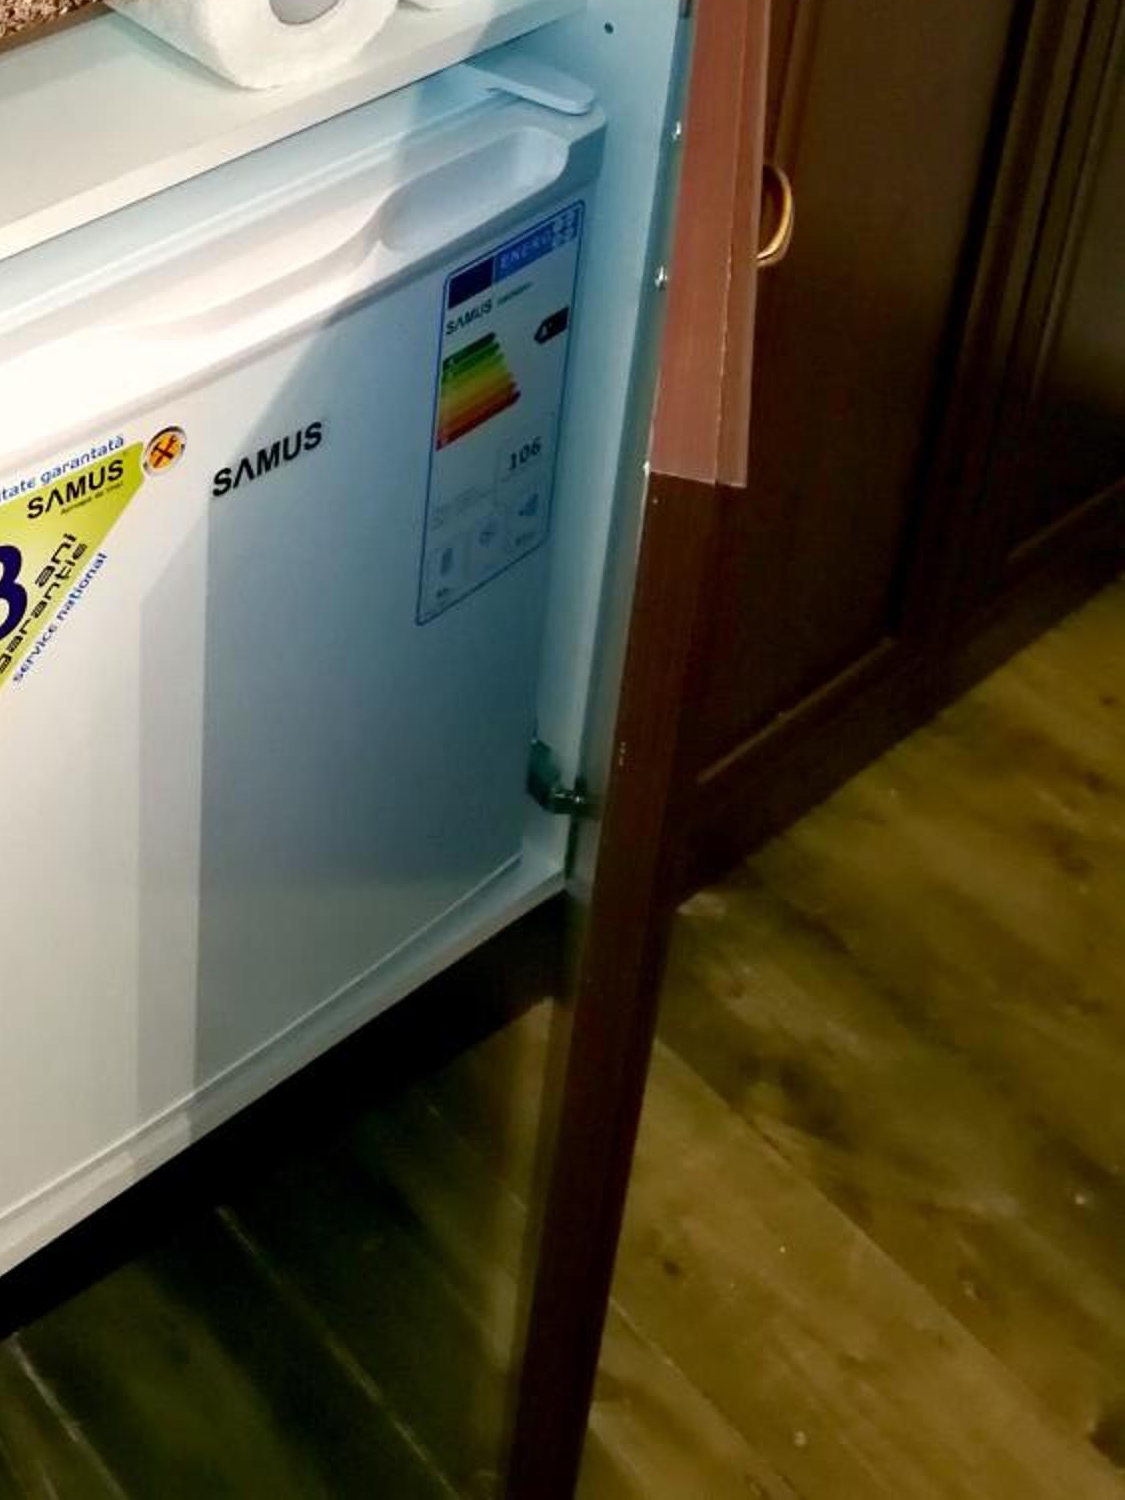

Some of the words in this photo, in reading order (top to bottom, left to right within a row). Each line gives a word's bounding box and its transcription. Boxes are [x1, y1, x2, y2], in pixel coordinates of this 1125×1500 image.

[445, 299, 492, 335] SAMUS
[212, 421, 322, 496] SAMUS
[510, 436, 541, 470] 106
[27, 459, 124, 519] SAMUS
[35, 533, 77, 588] ani
[13, 624, 57, 682] service
